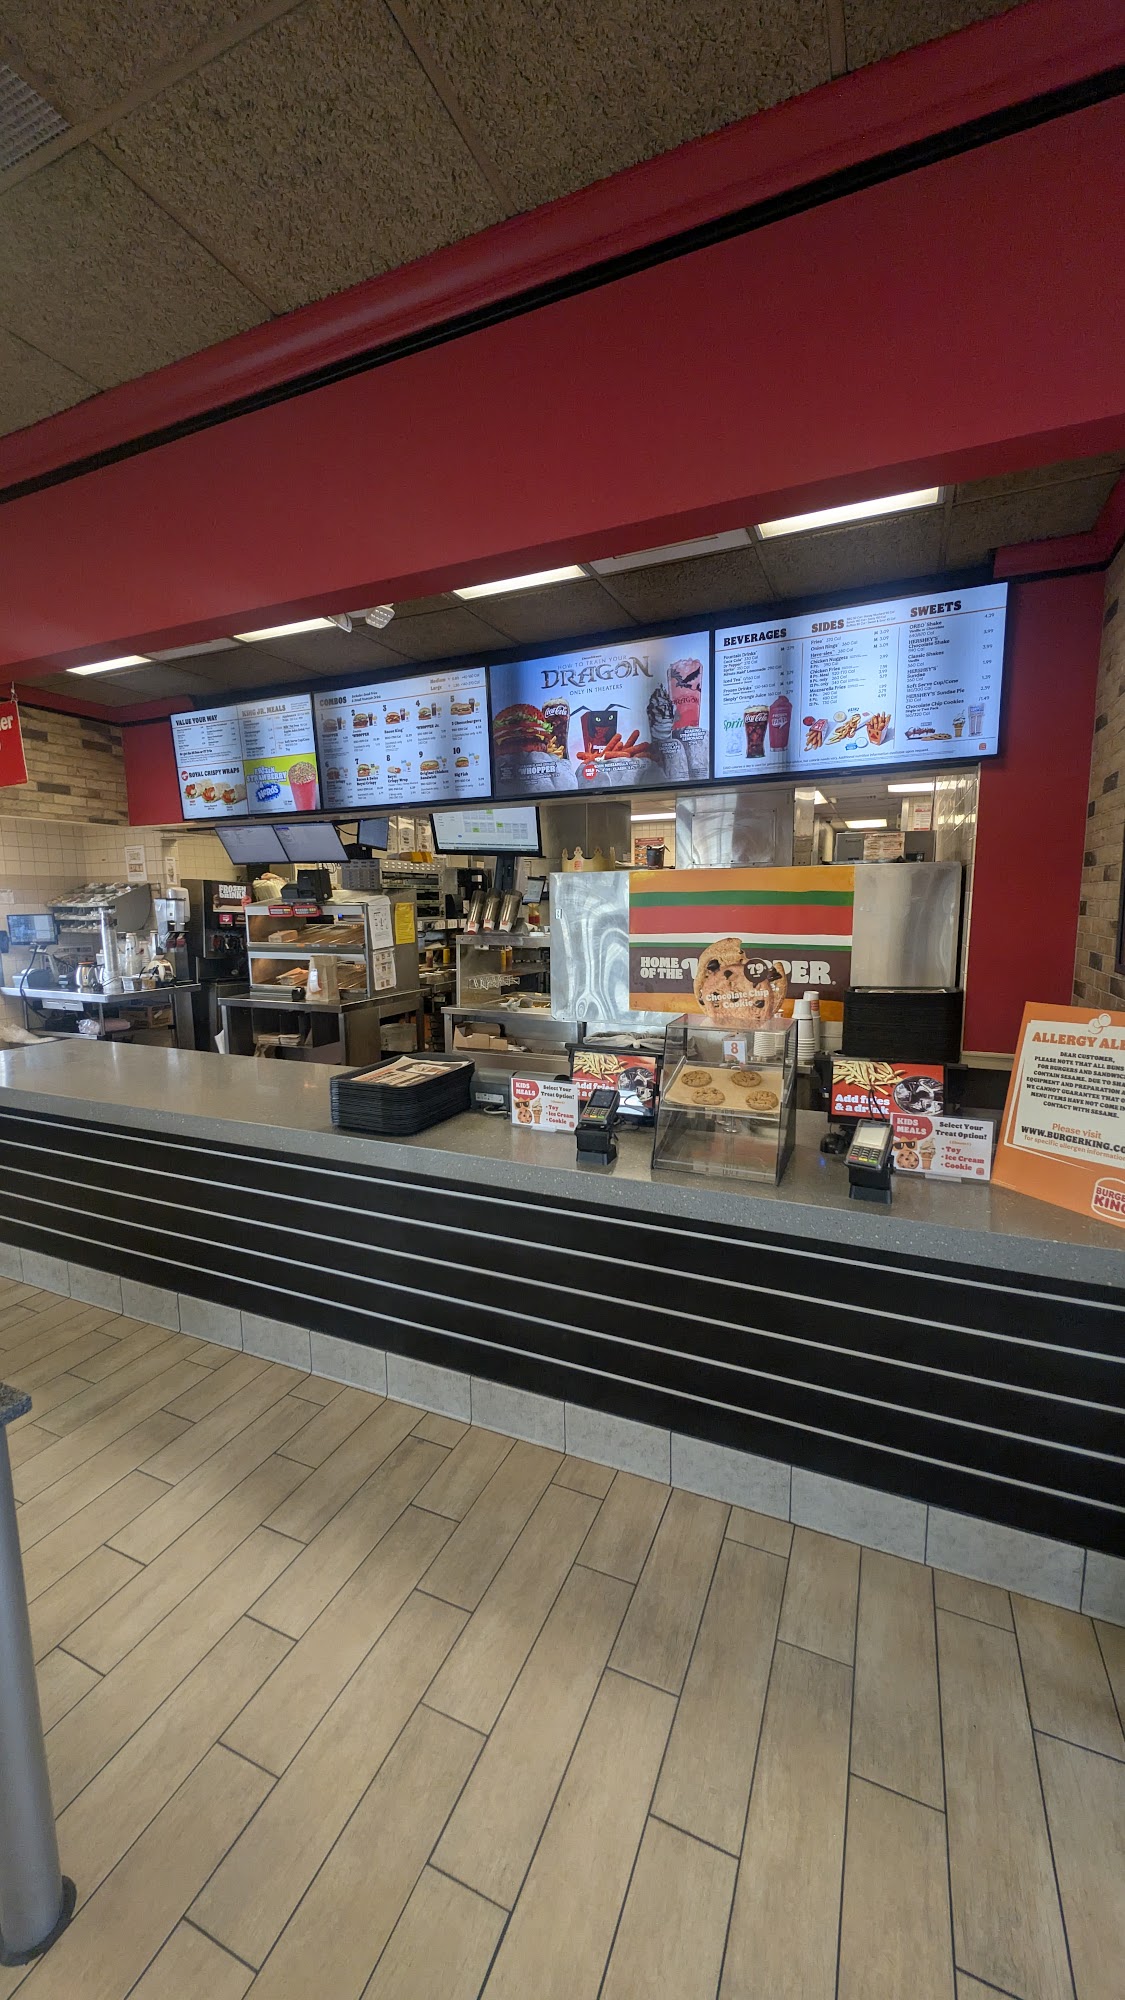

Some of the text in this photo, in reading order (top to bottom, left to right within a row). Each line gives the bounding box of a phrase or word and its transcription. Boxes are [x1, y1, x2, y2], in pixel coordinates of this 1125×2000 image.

[910, 601, 961, 617] SWEETS
[812, 619, 844, 633] SIDES
[724, 628, 786, 646] BEVERAGES
[541, 656, 653, 689] DRAGON
[320, 697, 347, 706] COMBOS
[267, 705, 286, 714] MEALS
[724, 718, 744, 731] Sprit
[520, 766, 555, 775] WHOPPER
[247, 772, 287, 783] STRAWBERRY
[219, 884, 246, 893] FROZEN
[641, 957, 680, 968] HOME
[641, 968, 683, 980] OF THE
[706, 989, 769, 1001] Chocolate Chip
[1032, 1032, 1097, 1047] ALLERGY
[1077, 1054, 1115, 1063] CUSTOMER,
[1050, 1065, 1078, 1073] BURGERS
[1093, 1070, 1125, 1079] SANDWIC
[1026, 1077, 1060, 1085] EQUIPMENT
[1074, 1084, 1120, 1094] PREPARATION
[835, 1094, 890, 1105] Add fries
[1061, 1088, 1100, 1099] GUARANTEE
[854, 1104, 889, 1114] drink
[1043, 1101, 1072, 1110] CONTACT
[1091, 1109, 1119, 1118] SESAME.
[897, 1118, 918, 1126] KIDS
[897, 1126, 926, 1135] MEALS
[1052, 1123, 1102, 1139] Please visit
[1034, 1137, 1059, 1147] specific
[1060, 1143, 1086, 1152] allergen
